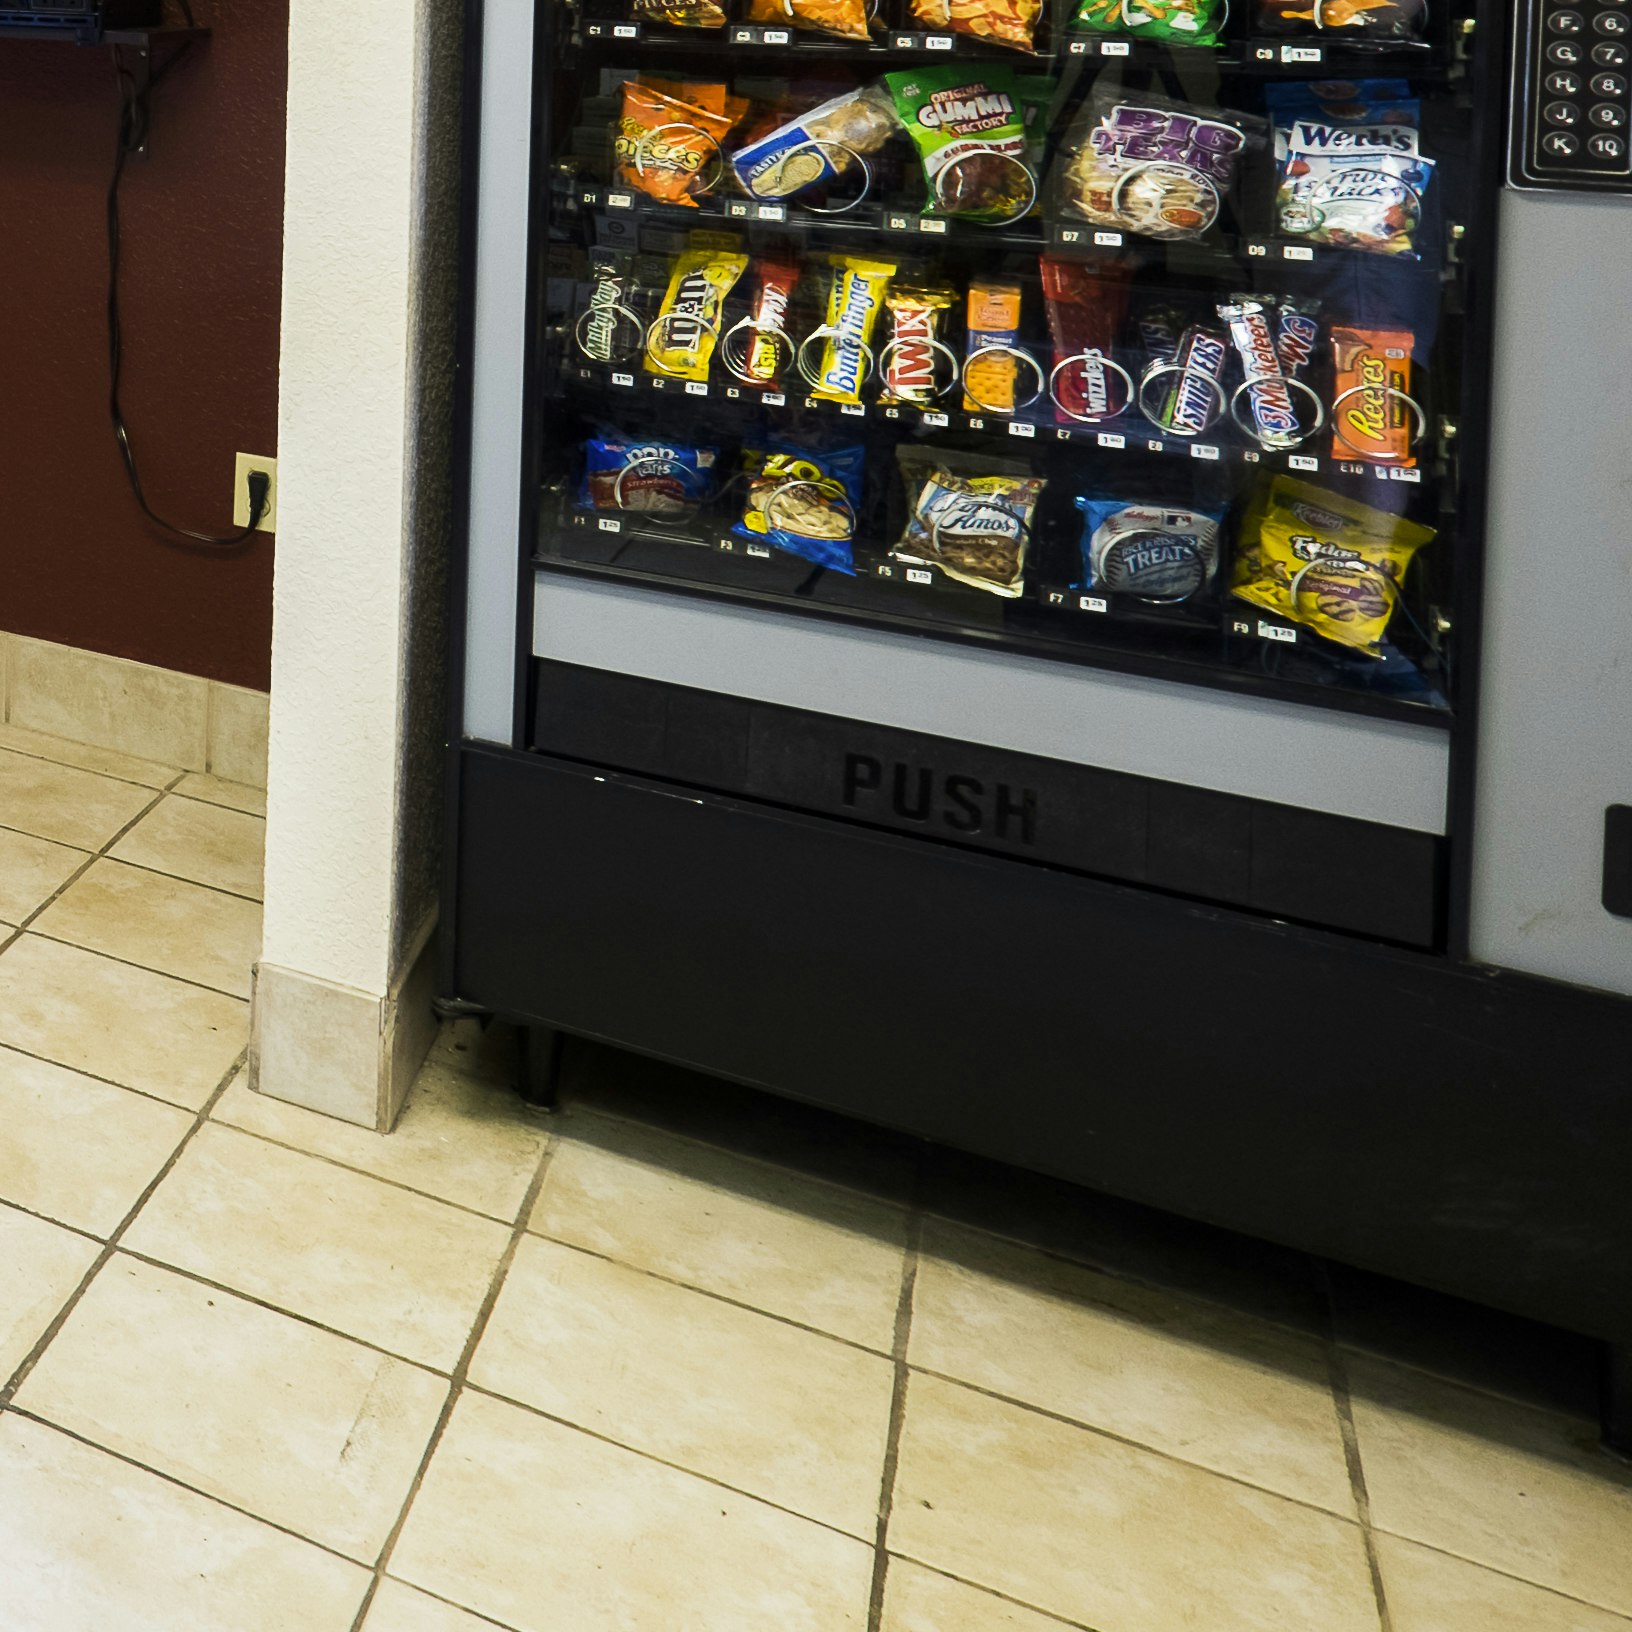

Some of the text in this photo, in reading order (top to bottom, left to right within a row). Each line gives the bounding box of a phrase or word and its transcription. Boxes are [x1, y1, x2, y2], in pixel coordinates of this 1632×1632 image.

[1559, 16, 1573, 28] F
[1604, 17, 1617, 30] 6
[1556, 47, 1572, 59] G
[1603, 48, 1616, 60] 7
[1555, 77, 1570, 89] H
[1602, 79, 1615, 91] 8
[918, 93, 1014, 127] GUMMI
[1555, 107, 1567, 120] J
[1601, 109, 1614, 122] 9
[953, 114, 1009, 134] FACTORY
[1111, 106, 1245, 152] BIG
[1553, 137, 1567, 150] K
[1597, 140, 1617, 152] 10
[1090, 127, 1236, 181] TEXAS
[888, 308, 936, 388] TWIX
[1184, 332, 1225, 432] SNICERS
[1250, 314, 1293, 431] 3 Muketeers
[1346, 354, 1386, 441] Reese's
[944, 512, 1018, 534] Amos
[1123, 546, 1197, 576] TREATS
[842, 752, 1039, 846] PUSH
